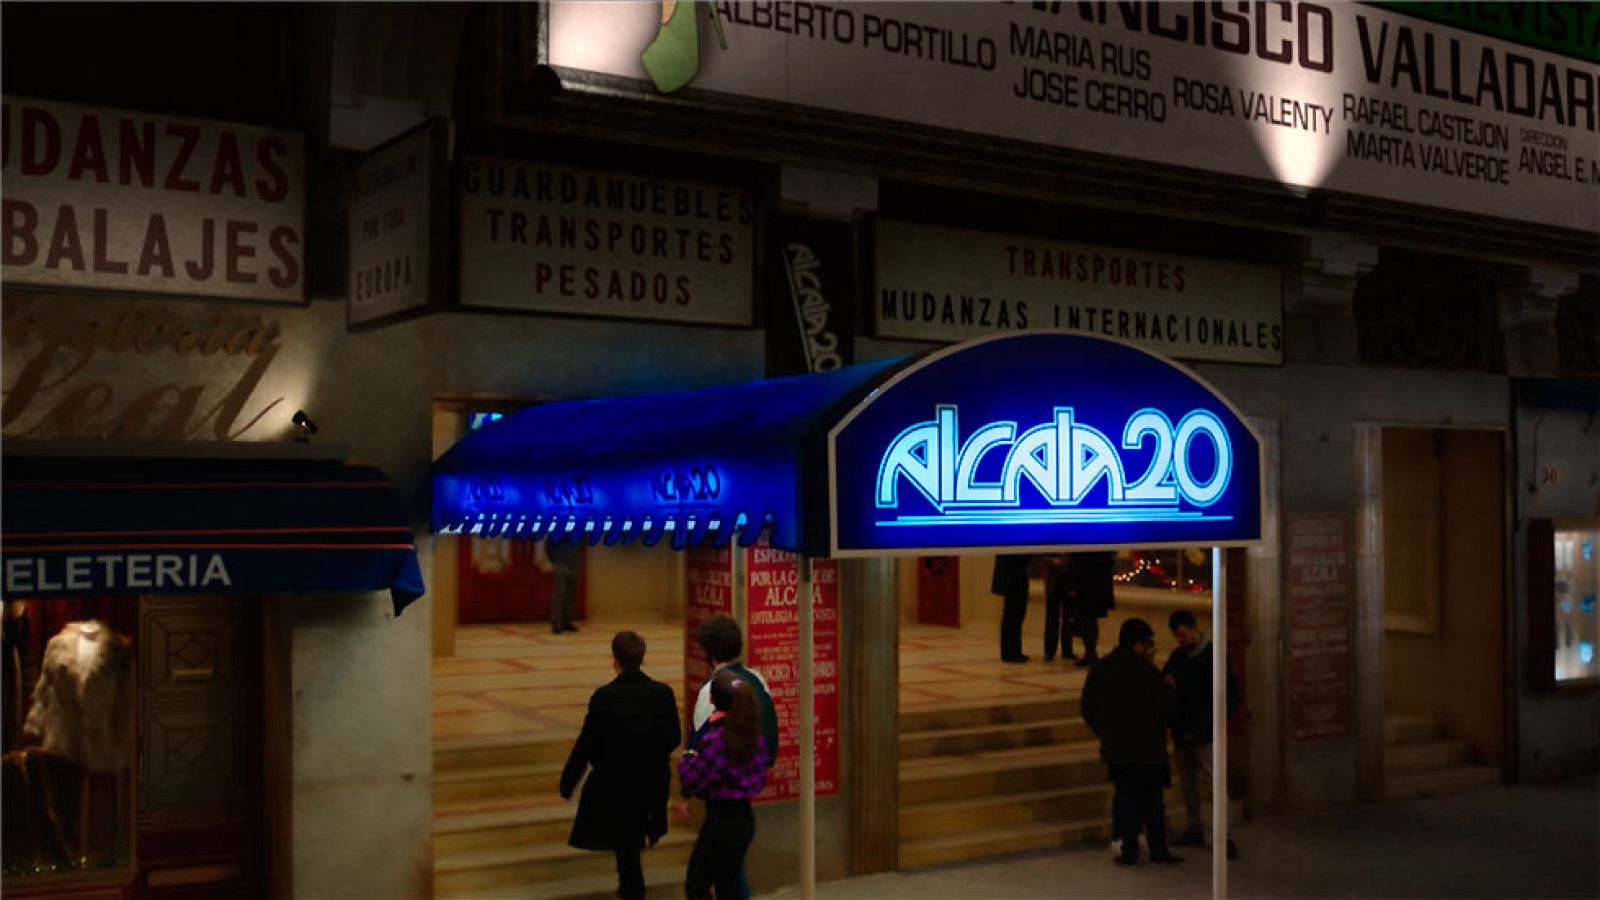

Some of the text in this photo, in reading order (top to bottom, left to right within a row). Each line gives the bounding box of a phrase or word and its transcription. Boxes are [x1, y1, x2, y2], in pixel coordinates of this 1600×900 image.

[864, 15, 996, 72] PORTILLO
[1010, 23, 1151, 80] MARIA RUS
[1014, 67, 1166, 122] JOSE CERRO
[1356, 15, 1600, 131] VALLADAR
[1173, 77, 1335, 135] ROSA VALENTY
[1343, 93, 1509, 152] RAFAEL CASTEJON
[1, 103, 289, 202] DANZAS
[1347, 129, 1510, 186] MARTA VALVERDE
[1519, 146, 1573, 181] ANGEL
[464, 160, 752, 227] GUARDAMUEBLES
[1, 199, 300, 288] BALAJES
[486, 208, 733, 264] TRANSPORTES
[355, 255, 411, 301] EUROPA
[536, 262, 691, 305] PESADOS
[1006, 245, 1186, 292] TRANSPORTES
[882, 289, 1281, 351] MUDANZAS INTERNACIONALES
[6, 553, 232, 593] ELETERIA
[764, 585, 824, 608] ALCA
